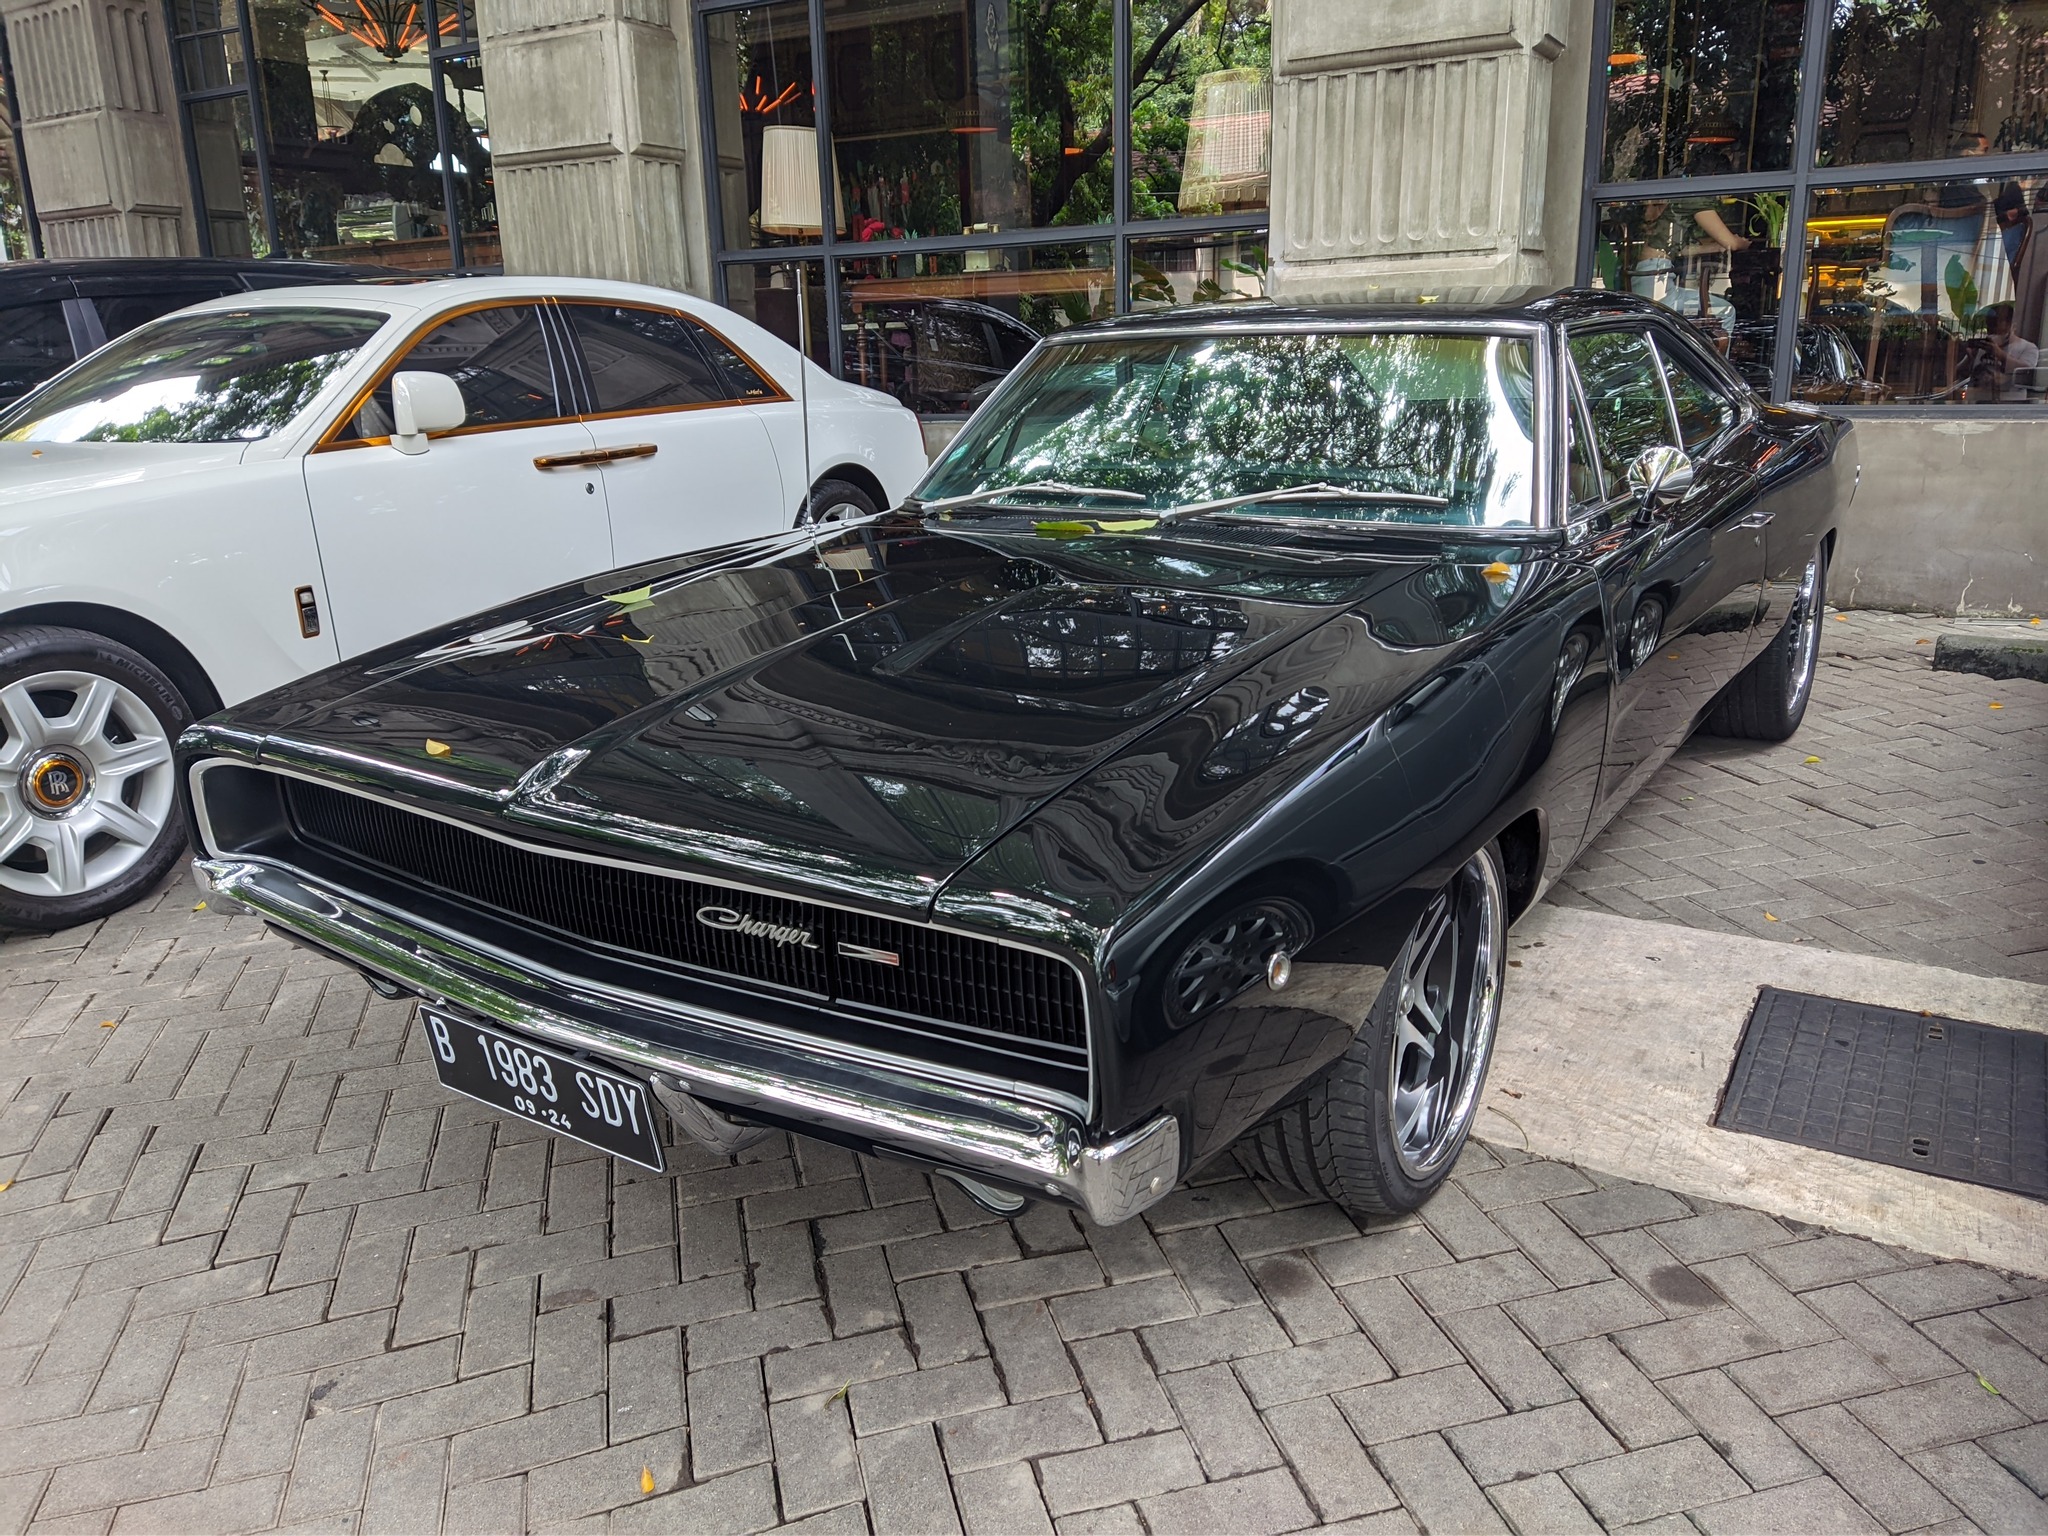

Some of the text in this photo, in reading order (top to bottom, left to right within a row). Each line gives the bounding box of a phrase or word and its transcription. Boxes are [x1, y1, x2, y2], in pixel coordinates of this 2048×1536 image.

[116, 657, 174, 706] MICHELIN
[696, 906, 820, 949] Charger
[429, 1015, 640, 1136] B 1983 SDY
